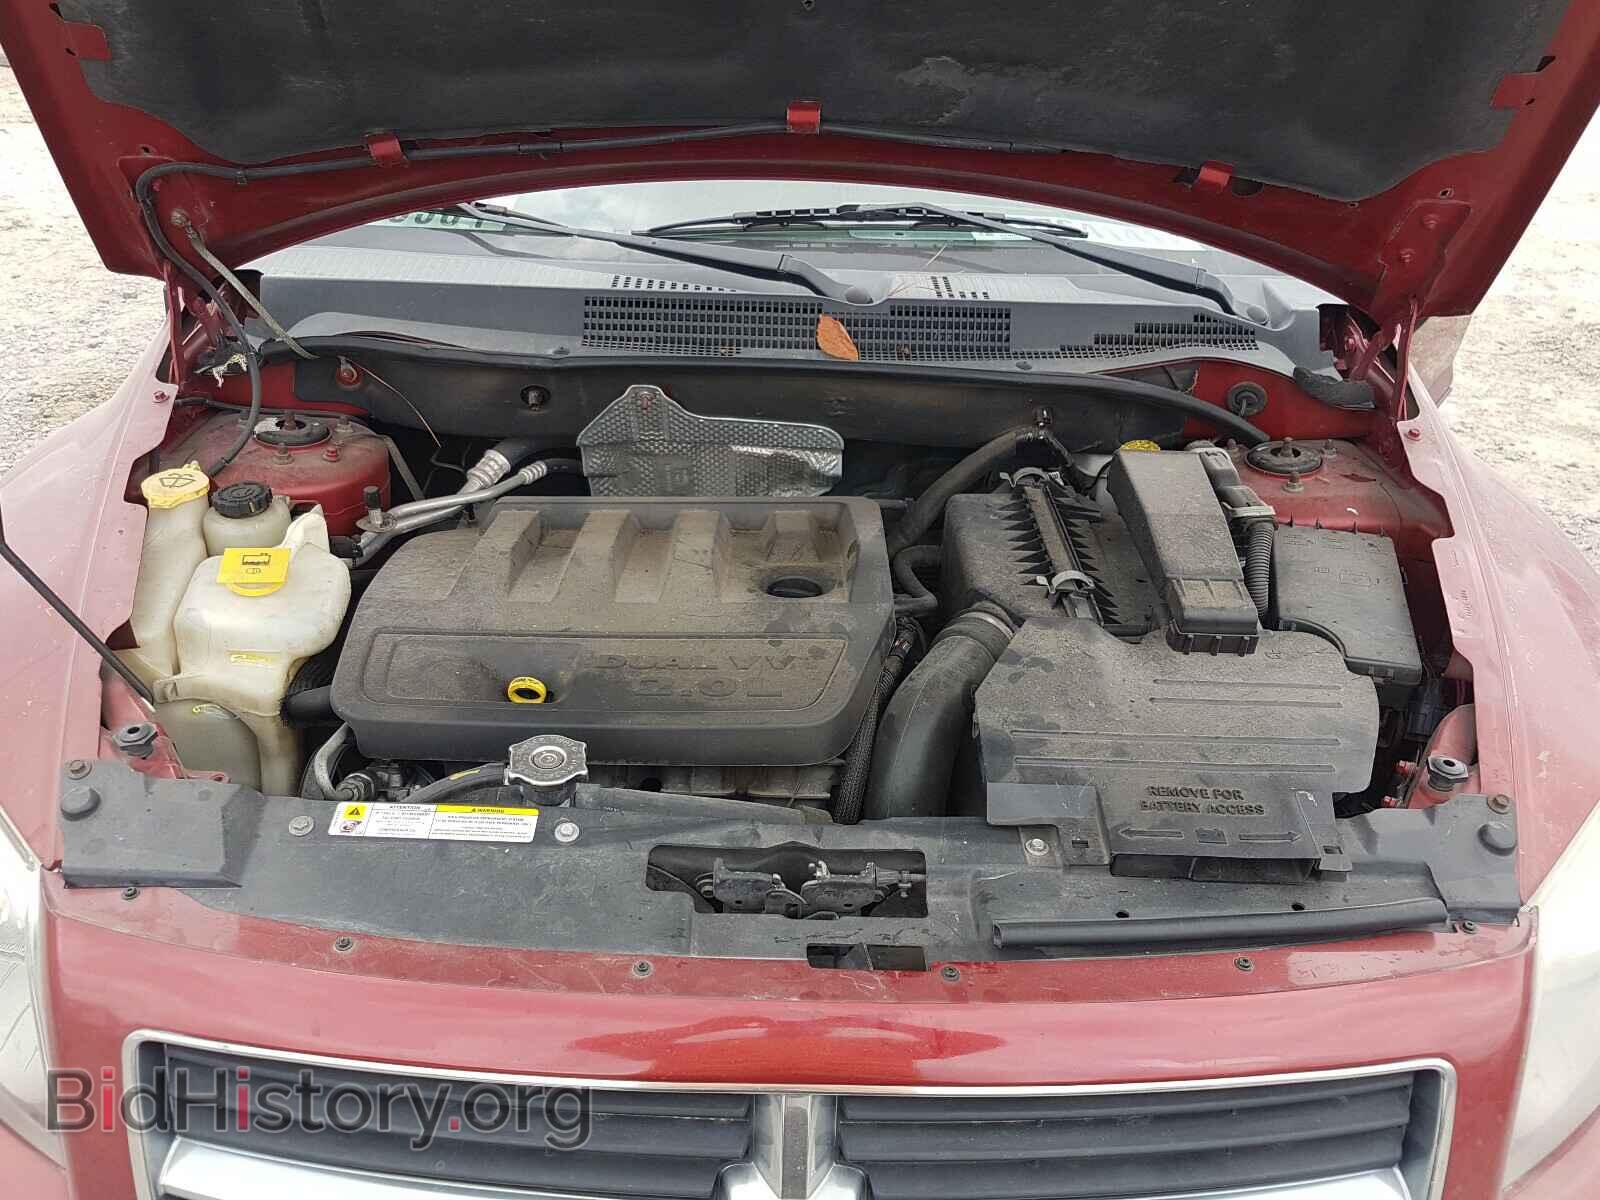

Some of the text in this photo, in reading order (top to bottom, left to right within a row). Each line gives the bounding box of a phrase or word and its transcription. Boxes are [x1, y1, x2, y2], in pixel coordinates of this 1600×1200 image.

[594, 655, 826, 671] DUAL VV
[1146, 786, 1244, 801] REMOVE FOR
[1140, 801, 1265, 816] BATTERY ACCESS
